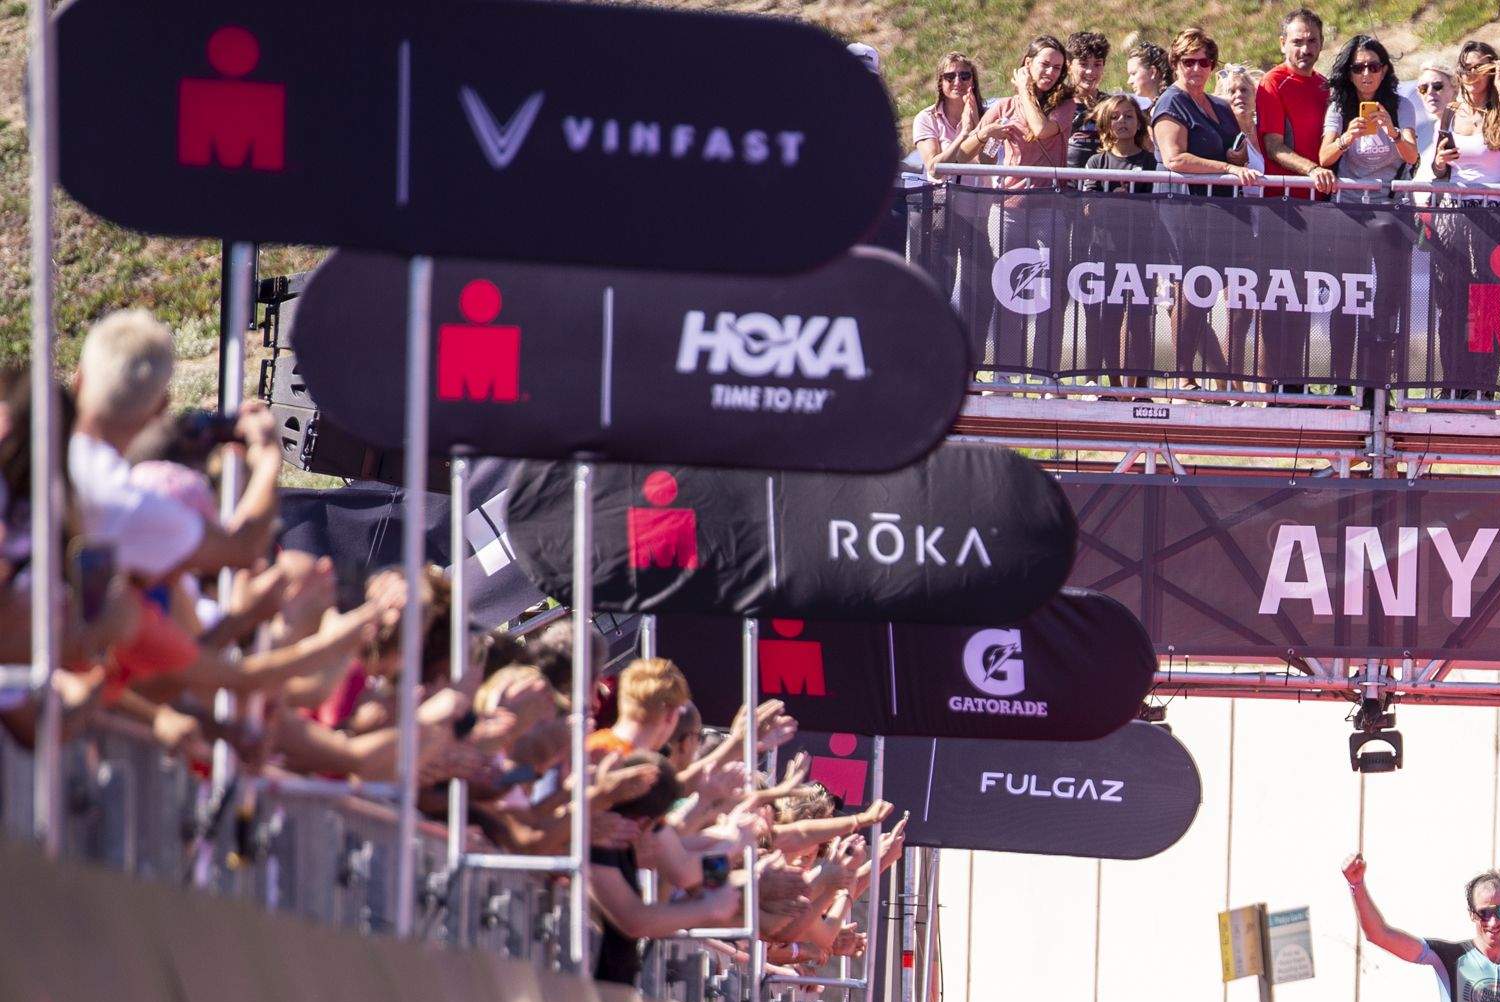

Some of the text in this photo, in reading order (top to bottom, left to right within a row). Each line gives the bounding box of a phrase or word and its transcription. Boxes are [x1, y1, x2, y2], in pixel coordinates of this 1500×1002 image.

[563, 115, 805, 165] VINFAST
[1066, 261, 1374, 316] GATORADE
[676, 310, 866, 380] HOKA
[711, 383, 828, 414] TIME TO FLY
[948, 695, 1048, 718] GATORADE
[979, 770, 1125, 803] FULGAZ
